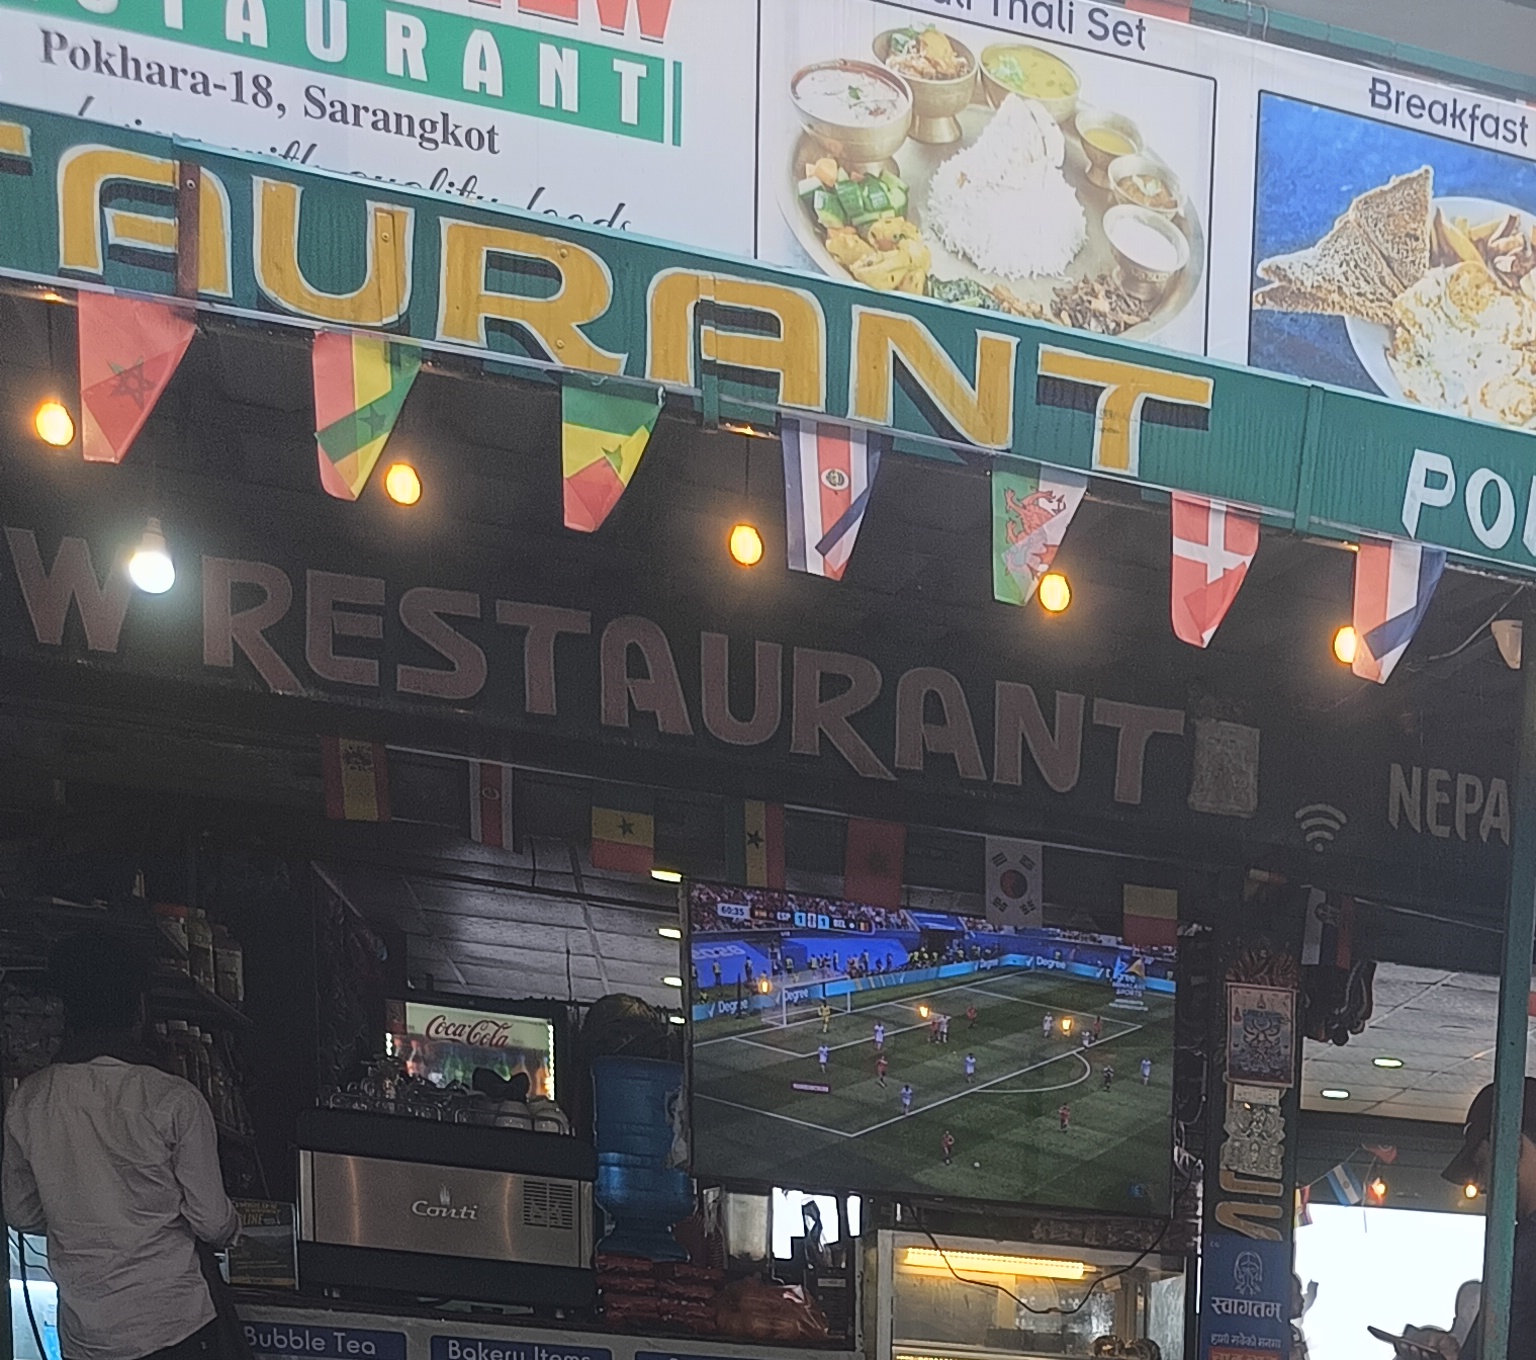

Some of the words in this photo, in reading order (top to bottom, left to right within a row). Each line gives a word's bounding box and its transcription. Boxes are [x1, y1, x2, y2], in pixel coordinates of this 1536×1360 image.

[77, 0, 647, 126] AURANT
[1087, 7, 1147, 51] Set
[37, 25, 286, 119] Pokhara-18,
[303, 84, 502, 156] Sarangkot
[1368, 76, 1529, 147] Breakfast
[0, 120, 1214, 477] AURANT
[199, 553, 1186, 804] RESTAURANT
[411, 1200, 479, 1220] Conti
[243, 1325, 327, 1351] Bubble
[333, 1331, 376, 1356] Tea
[1211, 1296, 1282, 1323] स्वागतम्
